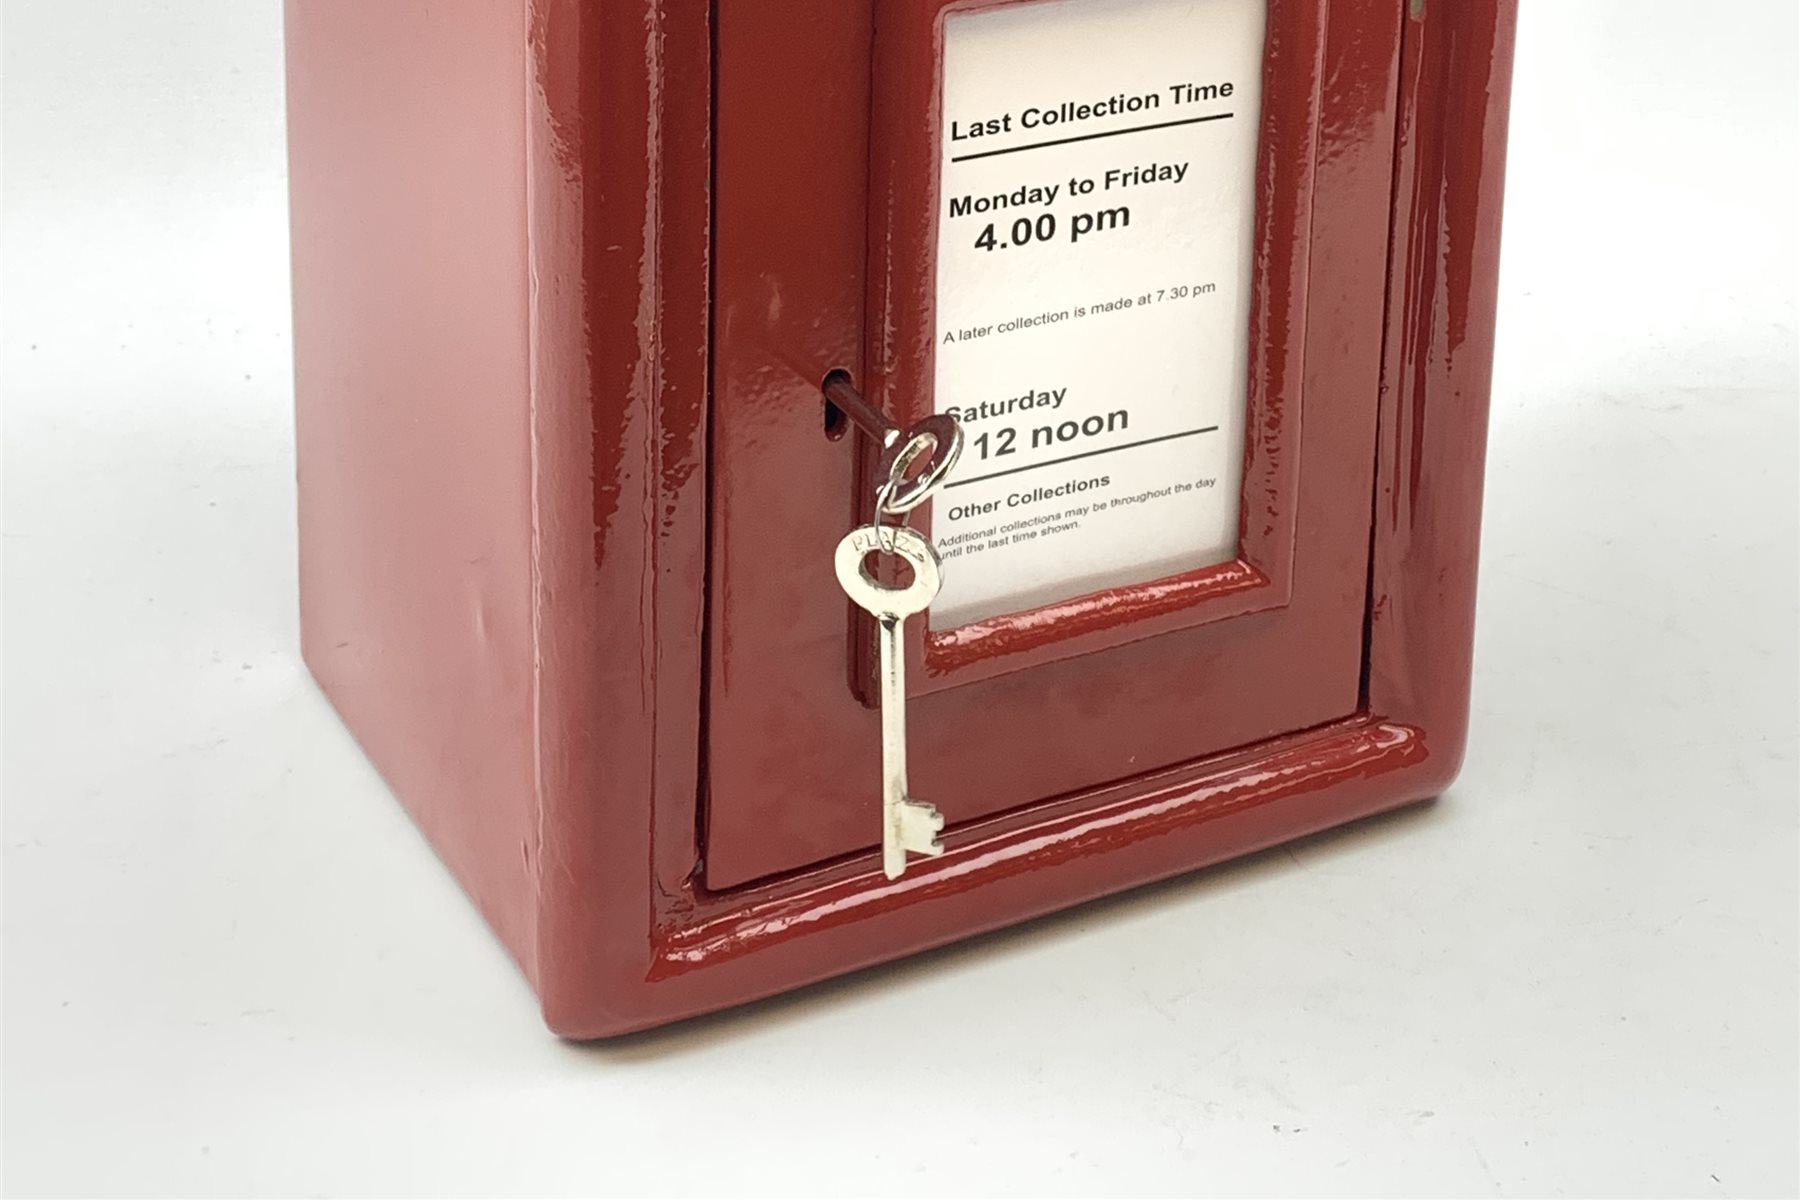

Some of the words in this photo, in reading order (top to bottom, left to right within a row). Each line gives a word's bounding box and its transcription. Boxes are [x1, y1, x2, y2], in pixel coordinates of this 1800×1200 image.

[951, 113, 1012, 141] Last
[1021, 93, 1160, 128] Collection
[1169, 82, 1234, 106] Time
[949, 184, 1060, 218] Monday
[1068, 178, 1095, 196] to
[1104, 162, 1189, 191] Friday
[974, 213, 1056, 251] 4.00
[1070, 205, 1131, 243] pm
[943, 331, 956, 345] A
[958, 325, 994, 342] later
[997, 310, 1070, 333] collection
[1073, 306, 1087, 318] is
[1090, 297, 1133, 315] made
[1137, 292, 1153, 306] at
[1156, 285, 1189, 302] 7.30
[1192, 282, 1216, 298] pm
[945, 387, 1067, 423] Saturday
[974, 427, 1017, 460] 12
[1031, 409, 1130, 449] noon
[937, 526, 997, 548] Additional
[1000, 513, 1062, 533] collections
[1064, 505, 1090, 518] may
[1092, 502, 1108, 512] be
[1110, 486, 1172, 508] throughout
[1174, 482, 1193, 494] the
[1195, 477, 1217, 490] day
[948, 499, 1001, 521] Other
[1006, 475, 1111, 508] Collections
[940, 546, 963, 561] until
[966, 543, 985, 555] the
[987, 535, 1009, 550] last
[1012, 529, 1038, 544] time
[1040, 520, 1081, 537] shown.
